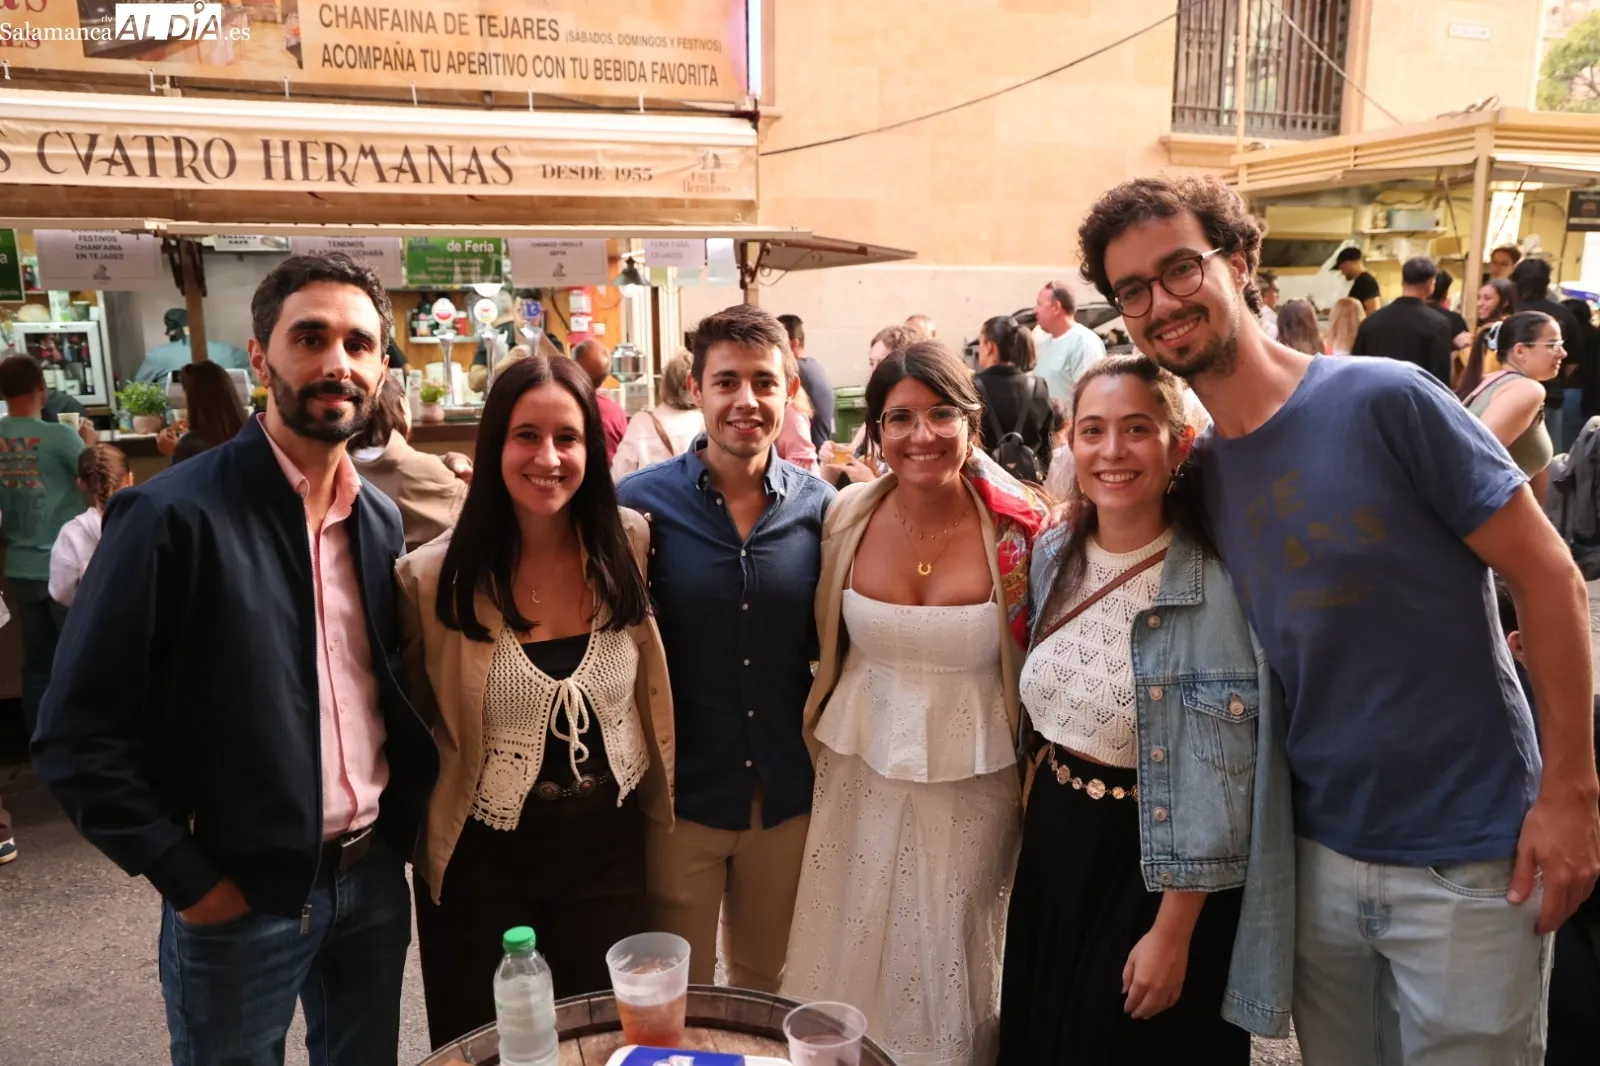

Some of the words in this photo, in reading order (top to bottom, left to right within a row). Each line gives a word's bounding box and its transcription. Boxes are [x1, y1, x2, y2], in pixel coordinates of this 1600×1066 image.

[319, 4, 438, 35] CHANFAINA
[443, 12, 470, 36] DE
[475, 13, 560, 42] TEJARES
[617, 34, 668, 48] DOMINGOS
[321, 41, 417, 73] ACOMPAÑA
[420, 48, 442, 74] TU
[446, 51, 528, 78] APERITIVO
[532, 55, 566, 79] CON
[569, 57, 589, 81] TU
[594, 58, 648, 83] BEBIDA
[651, 61, 719, 87] FAVORITA
[260, 138, 514, 188] HERMANAS
[541, 164, 606, 181] DESDE
[614, 166, 653, 182] 1955
[78, 234, 118, 242] FESTIVOS
[447, 239, 461, 253] de
[464, 240, 494, 253] Feria
[76, 252, 88, 260] EN
[89, 252, 125, 260] TEJARES
